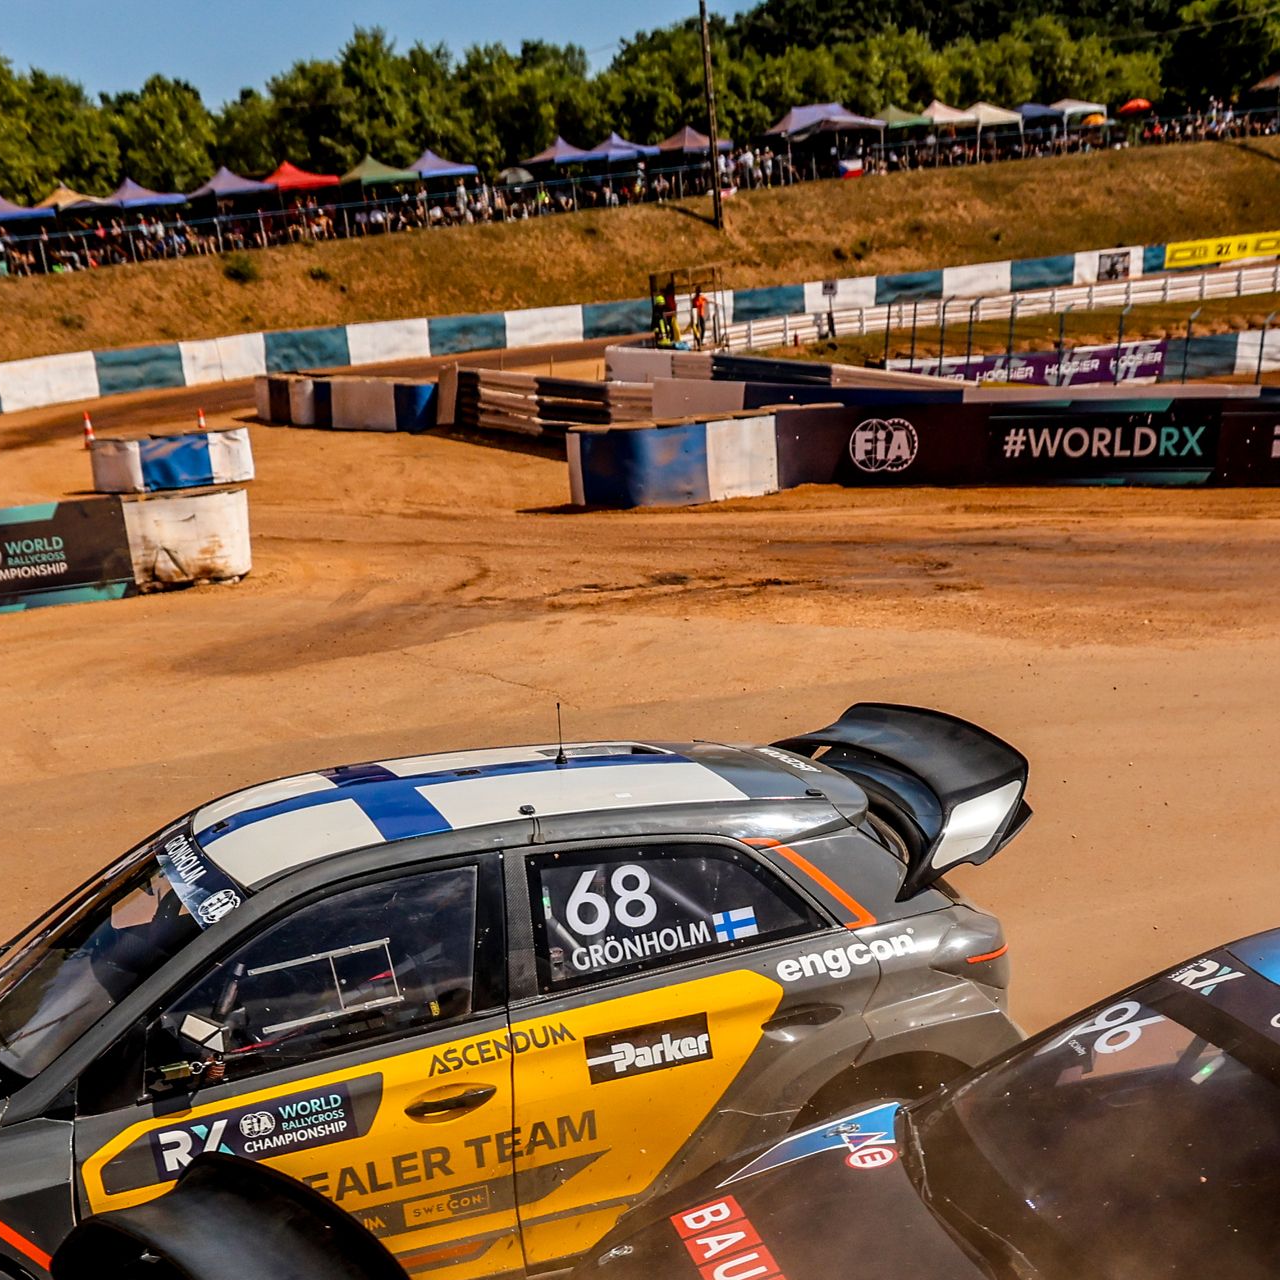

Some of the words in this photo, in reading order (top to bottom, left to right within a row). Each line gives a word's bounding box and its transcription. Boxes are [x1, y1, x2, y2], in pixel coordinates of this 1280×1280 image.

[1003, 426, 1206, 458] #WORLDRX
[5, 536, 64, 555] WORLD
[7, 551, 66, 566] RALLYCROSS
[565, 864, 658, 936] 68
[572, 920, 712, 971] GRÖNHOLM
[1172, 959, 1246, 996] RX
[1074, 1000, 1167, 1054] 96
[428, 1022, 577, 1077] ASCENDUM
[604, 1032, 710, 1073] Parker
[278, 1094, 342, 1119] WORLD
[281, 1108, 345, 1131] RALLYCROSS
[158, 1119, 236, 1172] RX
[244, 1120, 348, 1153] CHAMPIONSHIP
[302, 1146, 455, 1202] EALER
[464, 1109, 598, 1169] TEAM
